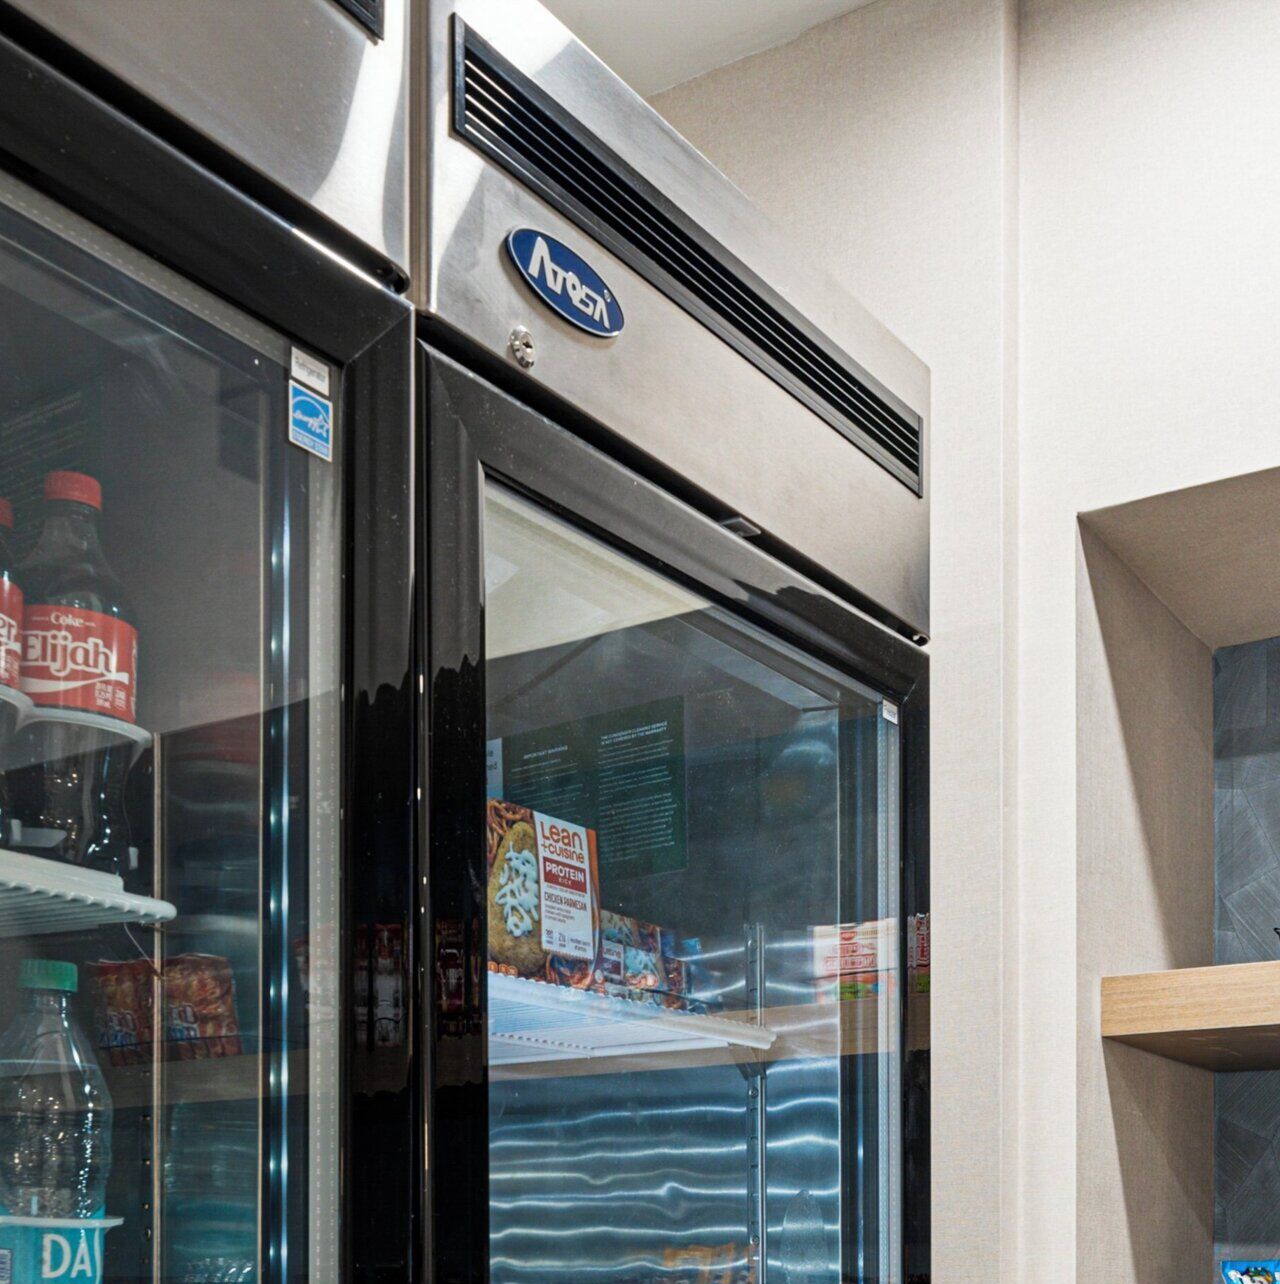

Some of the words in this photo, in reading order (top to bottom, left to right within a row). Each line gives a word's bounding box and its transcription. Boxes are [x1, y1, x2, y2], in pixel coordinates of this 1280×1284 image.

[49, 611, 85, 628] Coke
[21, 629, 118, 678] Elijah
[540, 821, 584, 851] Lean
[545, 862, 586, 883] PROTEIN
